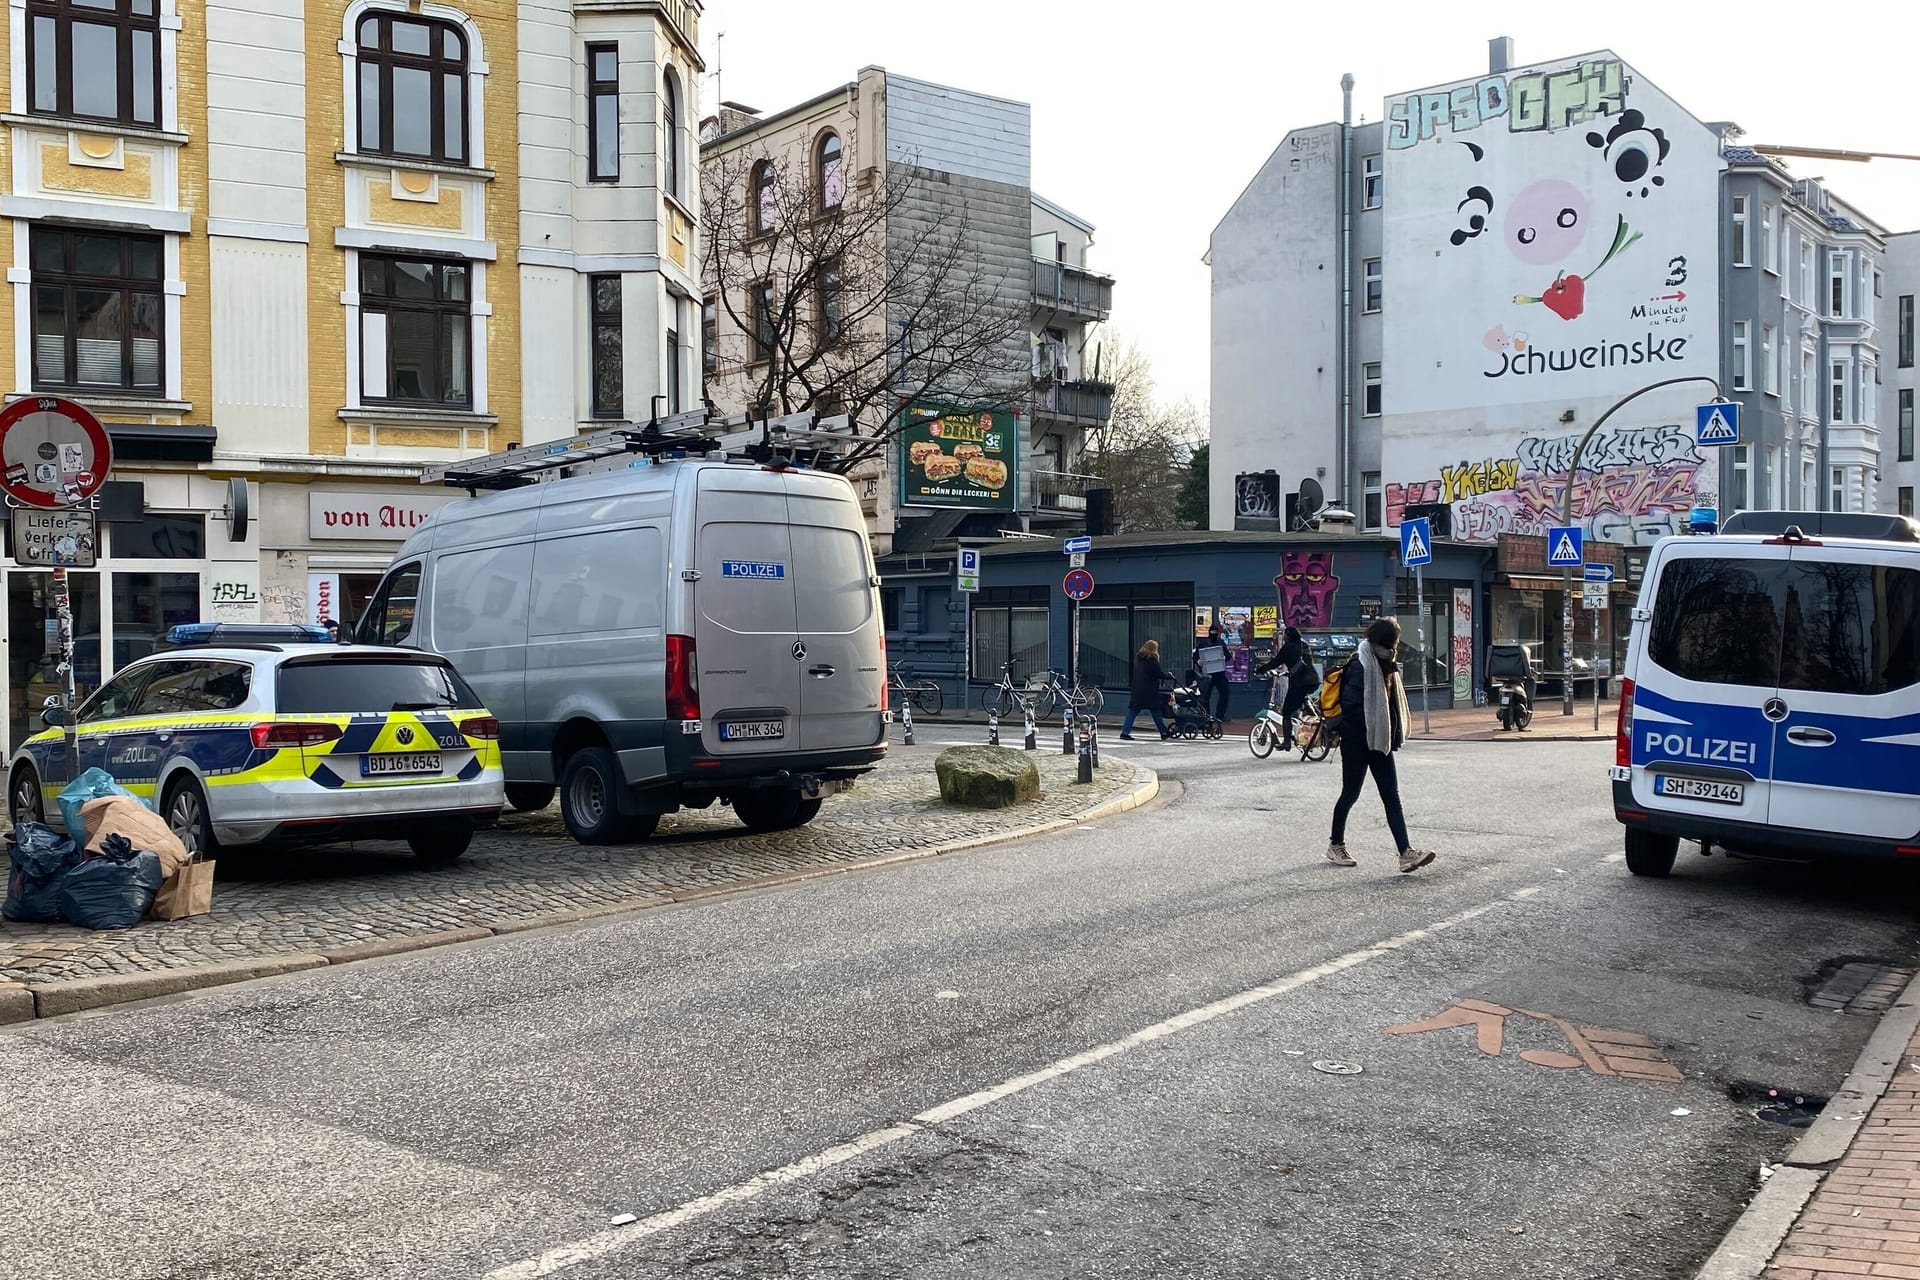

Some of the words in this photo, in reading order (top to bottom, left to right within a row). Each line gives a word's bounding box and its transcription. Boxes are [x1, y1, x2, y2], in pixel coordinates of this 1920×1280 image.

[1665, 255, 1688, 286] 3
[1630, 304, 1689, 320] Minuten
[1664, 314, 1686, 324] Fuß
[1483, 331, 1688, 378] Schweinske
[985, 433, 994, 446] 3
[951, 488, 963, 496] DIR
[28, 514, 78, 529] Liefer-
[324, 510, 369, 527] von
[25, 531, 75, 543] verk
[965, 553, 973, 566] P
[731, 563, 777, 577] POLIZEI
[728, 724, 742, 737] OH
[748, 724, 761, 736] HK
[764, 723, 782, 735] 364
[439, 736, 464, 747] ZOLL
[1645, 732, 1756, 764] POLIZEI
[370, 757, 386, 770] BD
[388, 756, 403, 769] 16
[412, 755, 440, 769] 6543
[1666, 779, 1685, 793] SH
[1694, 782, 1739, 800] 39146
